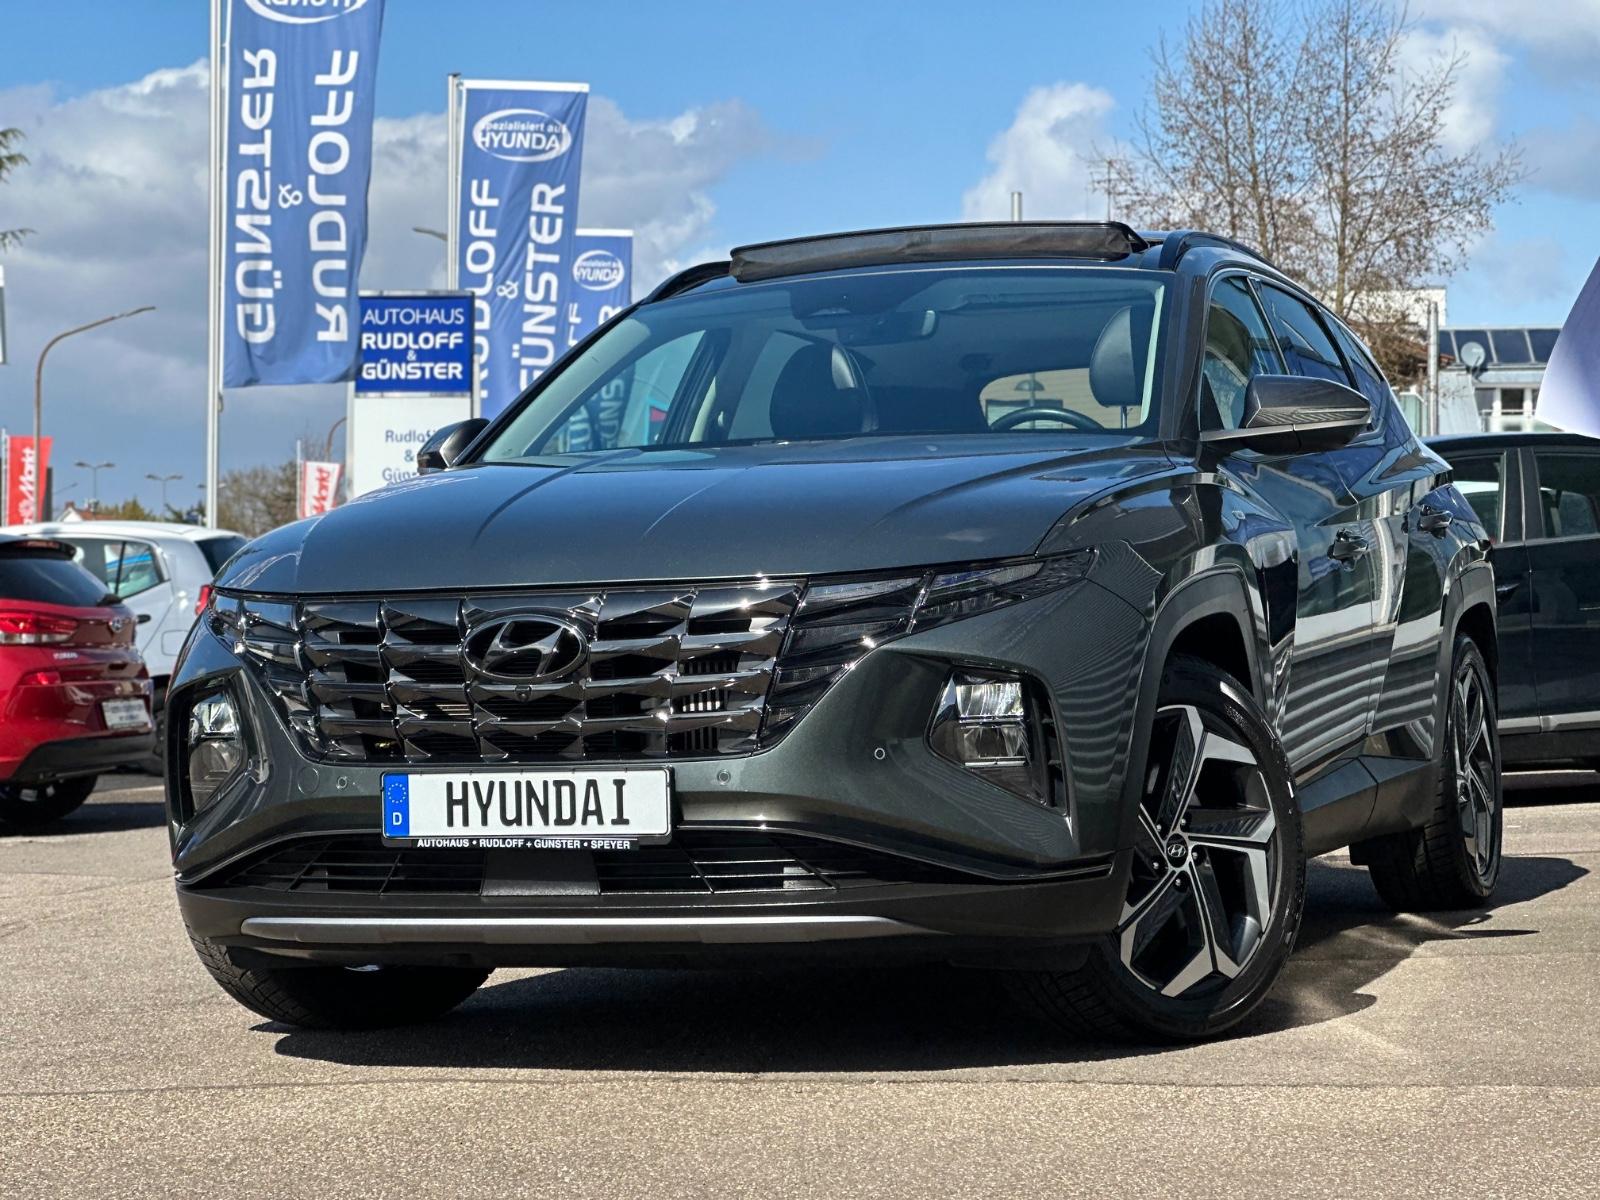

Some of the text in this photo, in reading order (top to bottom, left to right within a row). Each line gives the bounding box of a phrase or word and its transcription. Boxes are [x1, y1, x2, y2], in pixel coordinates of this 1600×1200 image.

[465, 179, 500, 399] UDLOFF
[496, 281, 519, 298] &
[362, 308, 464, 325] AUTOHAUS
[362, 332, 463, 349] RUDLOFF
[406, 350, 417, 361] &
[362, 358, 463, 380] GÜNSTER
[404, 450, 415, 462] &
[446, 779, 630, 827] HYUNDAI
[392, 812, 402, 825] D
[417, 838, 470, 848] AUTOHAUS
[479, 838, 524, 848] RUDLOFF
[590, 840, 631, 850] SPEYER
